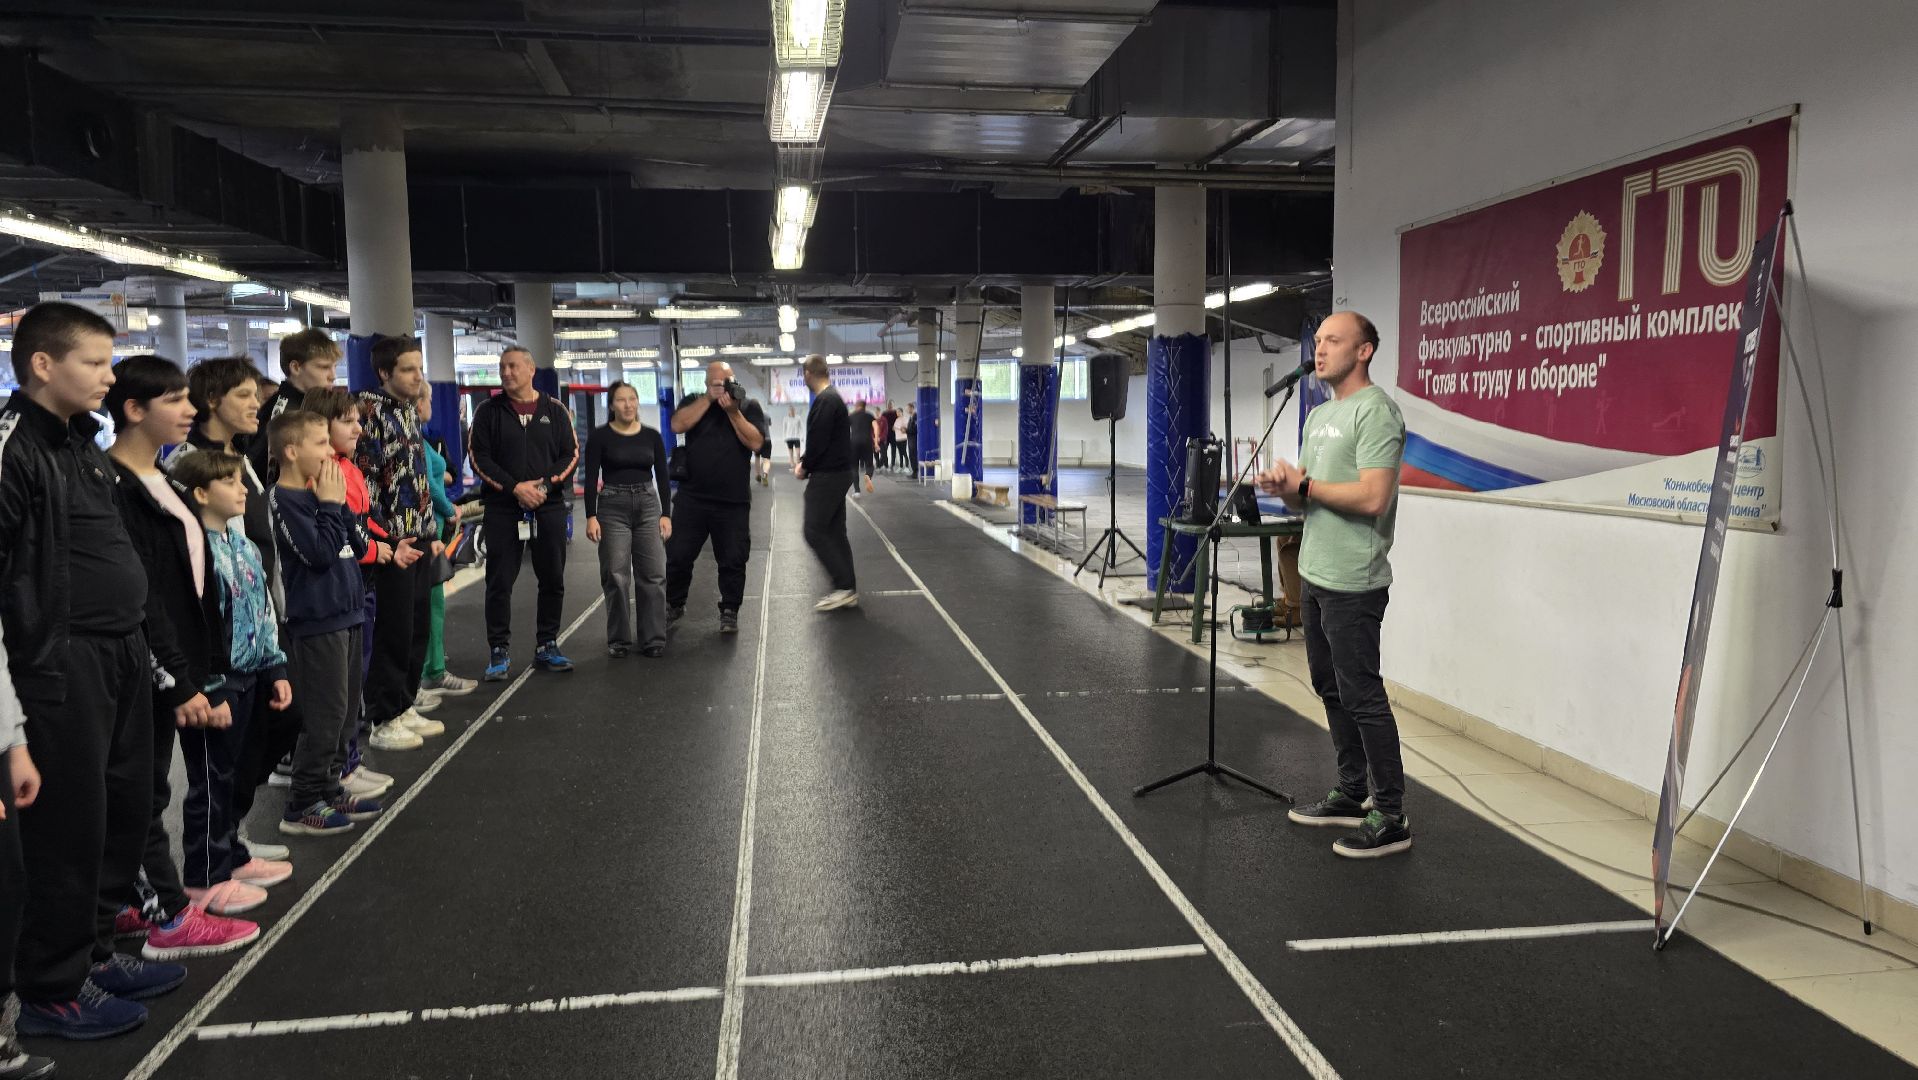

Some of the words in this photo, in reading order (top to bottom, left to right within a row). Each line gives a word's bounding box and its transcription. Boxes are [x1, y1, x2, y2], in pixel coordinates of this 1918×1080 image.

[1618, 145, 1759, 302] ГТО
[1573, 260, 1586, 270] ГТО
[1420, 281, 1519, 330] Всероссийский
[1418, 330, 1512, 367] физкультурно
[1536, 304, 1641, 355] спортивный
[1646, 301, 1744, 339] комплек
[1418, 368, 1457, 397] "Готов
[1460, 372, 1469, 393] к
[1472, 369, 1512, 400] труду
[1517, 367, 1526, 391] и
[1530, 353, 1607, 397] обороне"
[1628, 493, 1675, 509] Московской
[1733, 485, 1765, 500] центр
